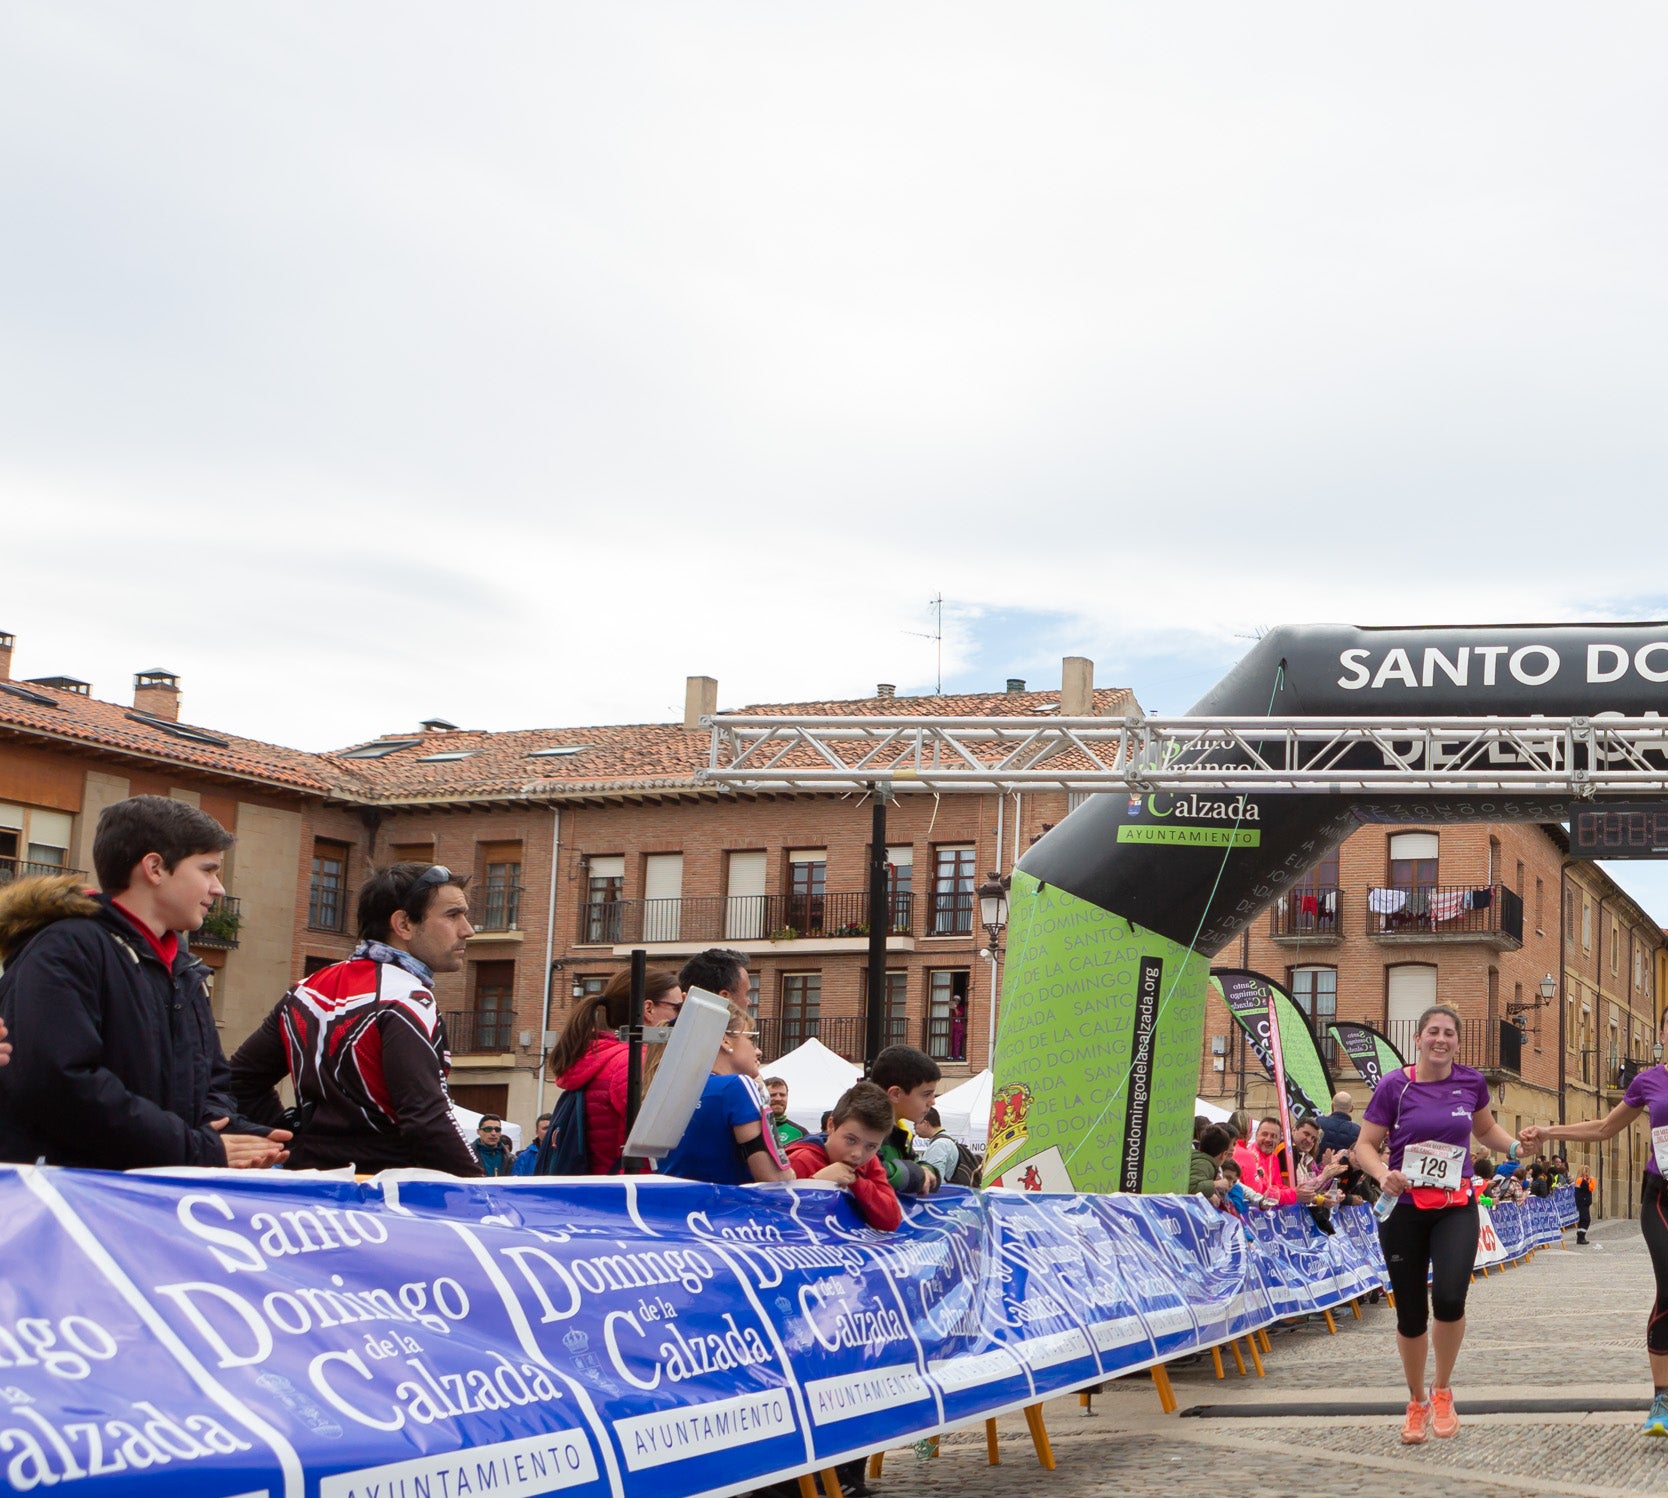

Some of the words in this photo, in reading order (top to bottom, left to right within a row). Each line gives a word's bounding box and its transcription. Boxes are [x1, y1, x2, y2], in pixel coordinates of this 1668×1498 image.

[1337, 645, 1560, 690] SANTO
[1148, 793, 1260, 820] Calzada
[1125, 827, 1252, 844] AYUNTAMIENTO
[1064, 926, 1125, 951] SANTO
[1038, 970, 1132, 1002] DOMINGO
[1045, 962, 1064, 978] LA
[1029, 1033, 1048, 1050] DE
[1053, 1027, 1074, 1043] LA
[1064, 1093, 1084, 1110] LA
[1420, 1156, 1448, 1179] 129
[177, 1193, 389, 1273] Santo
[500, 1240, 714, 1324] Domingo
[155, 1274, 471, 1369] Domingo
[637, 1298, 661, 1322] de
[655, 1296, 679, 1319] la
[798, 1284, 908, 1353] Calzada
[365, 1336, 396, 1361] de
[393, 1332, 424, 1354] la
[603, 1310, 772, 1391] Calzada
[308, 1350, 563, 1432] Calzada
[818, 1373, 920, 1413] AYUNTAMIENTO
[635, 1400, 785, 1455] AYUNTAMIENTO
